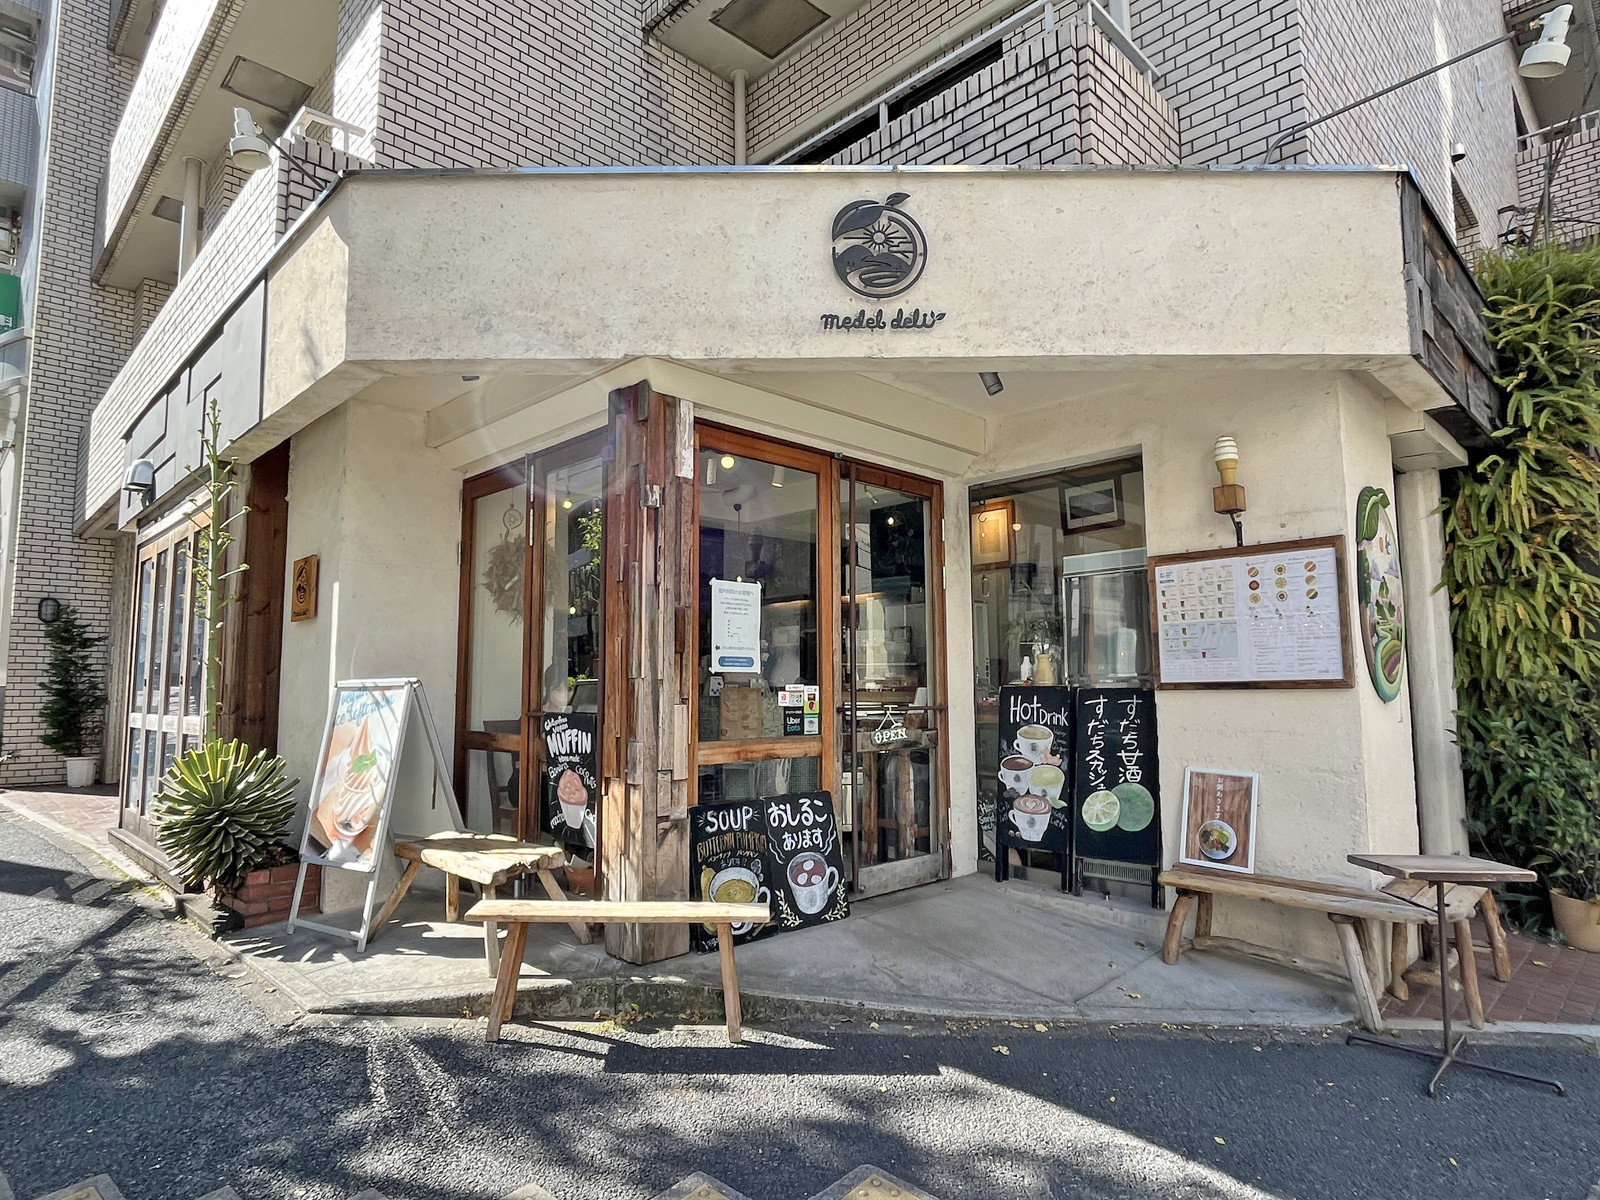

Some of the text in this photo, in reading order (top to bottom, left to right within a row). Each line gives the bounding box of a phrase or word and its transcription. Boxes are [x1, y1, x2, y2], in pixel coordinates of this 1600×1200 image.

[820, 308, 942, 331] medel deli
[786, 716, 801, 725] Uber
[1009, 694, 1069, 727] Hot Drink
[787, 724, 801, 732] Eats
[874, 727, 908, 744] OPEN
[1116, 694, 1144, 783] すだち甘酒
[546, 728, 592, 758] MUFFIN
[1084, 694, 1109, 791] すだちスカッシュ
[704, 805, 753, 833] SOUP
[767, 797, 828, 828] おしるこ
[781, 827, 824, 852] あります
